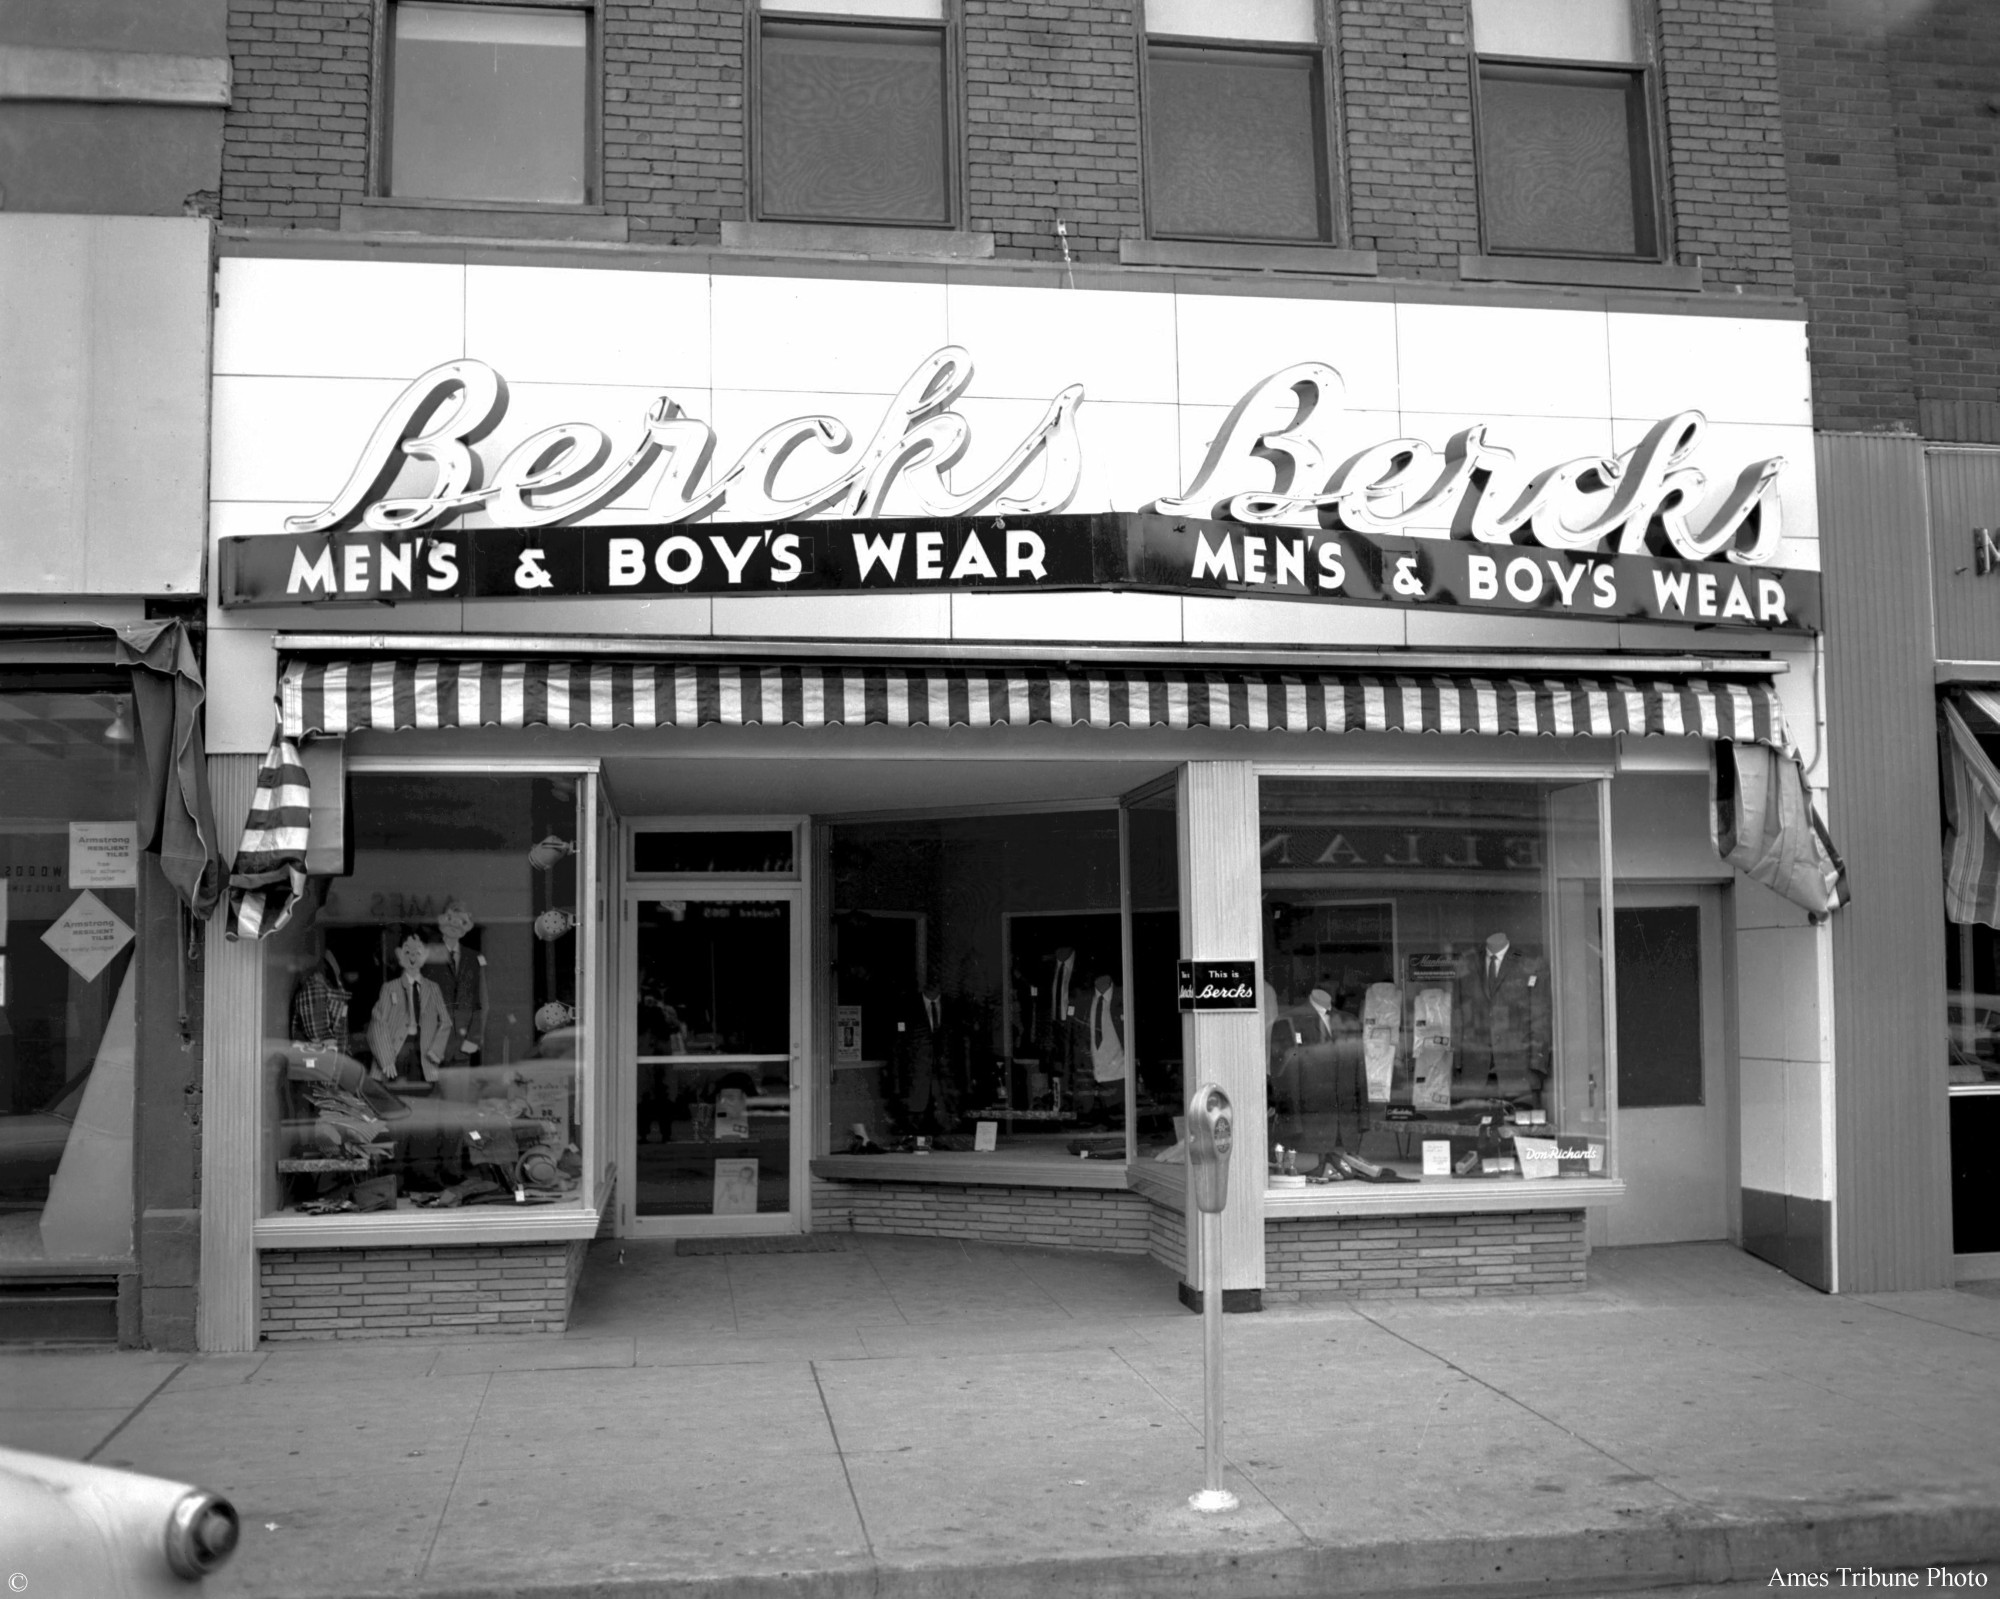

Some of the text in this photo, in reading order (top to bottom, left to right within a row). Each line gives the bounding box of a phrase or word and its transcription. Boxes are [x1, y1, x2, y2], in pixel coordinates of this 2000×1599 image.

[284, 345, 1084, 531] Bercks
[1140, 361, 1789, 565] Bercks
[286, 529, 1048, 594] MEN'S & BOY'S WEAR
[1191, 530, 1789, 624] MEN'S & BOY'S WEAR
[78, 836, 130, 844] Armstrong
[63, 920, 115, 929] Armstrong
[1208, 969, 1240, 978] This is
[1196, 983, 1253, 999] Bercks
[1525, 1144, 1597, 1160] Don Richards
